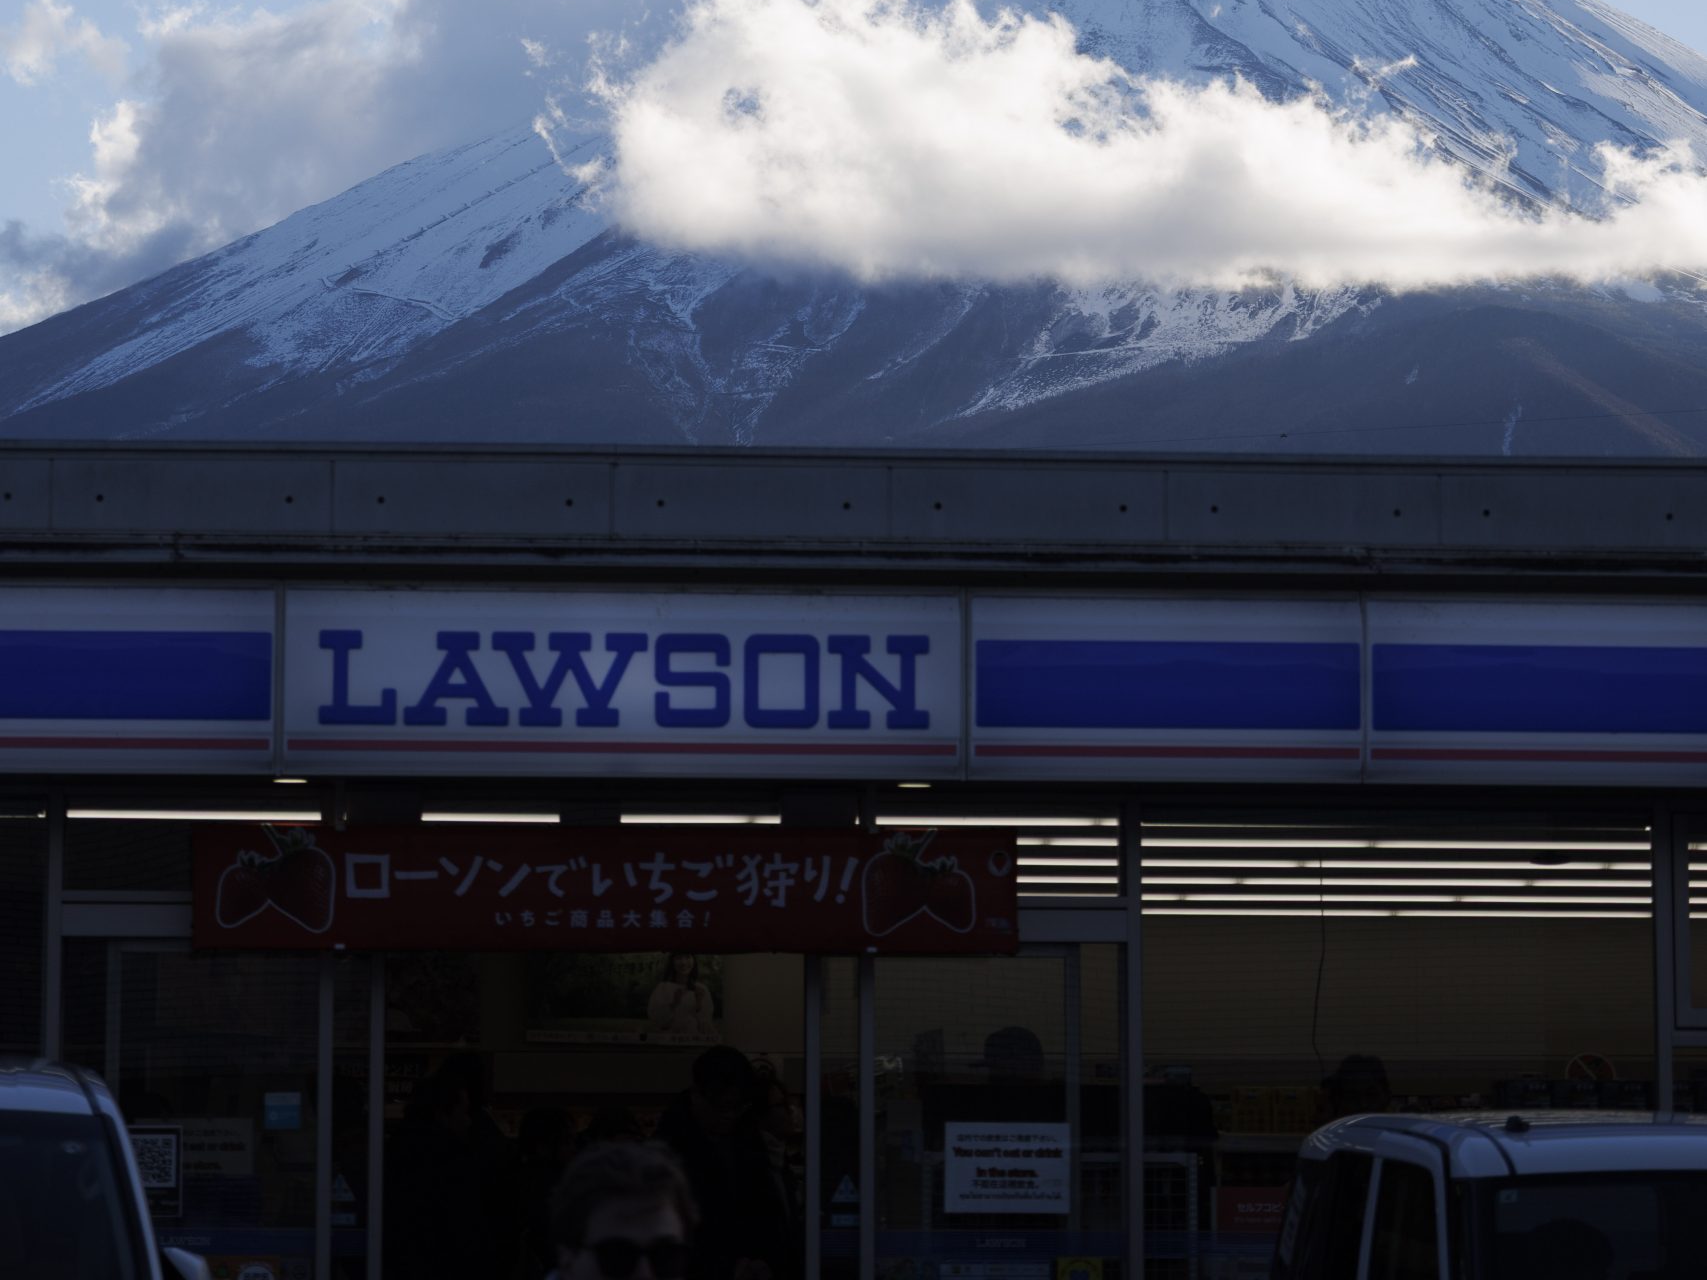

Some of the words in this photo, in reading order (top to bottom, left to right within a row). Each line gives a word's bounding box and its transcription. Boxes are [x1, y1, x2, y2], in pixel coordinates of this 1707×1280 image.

[318, 630, 930, 730] LAWSON
[345, 852, 859, 907] ローソンでいちご狩り!
[494, 909, 710, 928] いちご商品大集合!
[953, 1147, 973, 1157] You
[975, 1148, 1002, 1157] can't
[1004, 1149, 1021, 1157] eat
[1023, 1149, 1034, 1157] or
[1036, 1148, 1063, 1158] drink
[989, 1167, 1006, 1177] the
